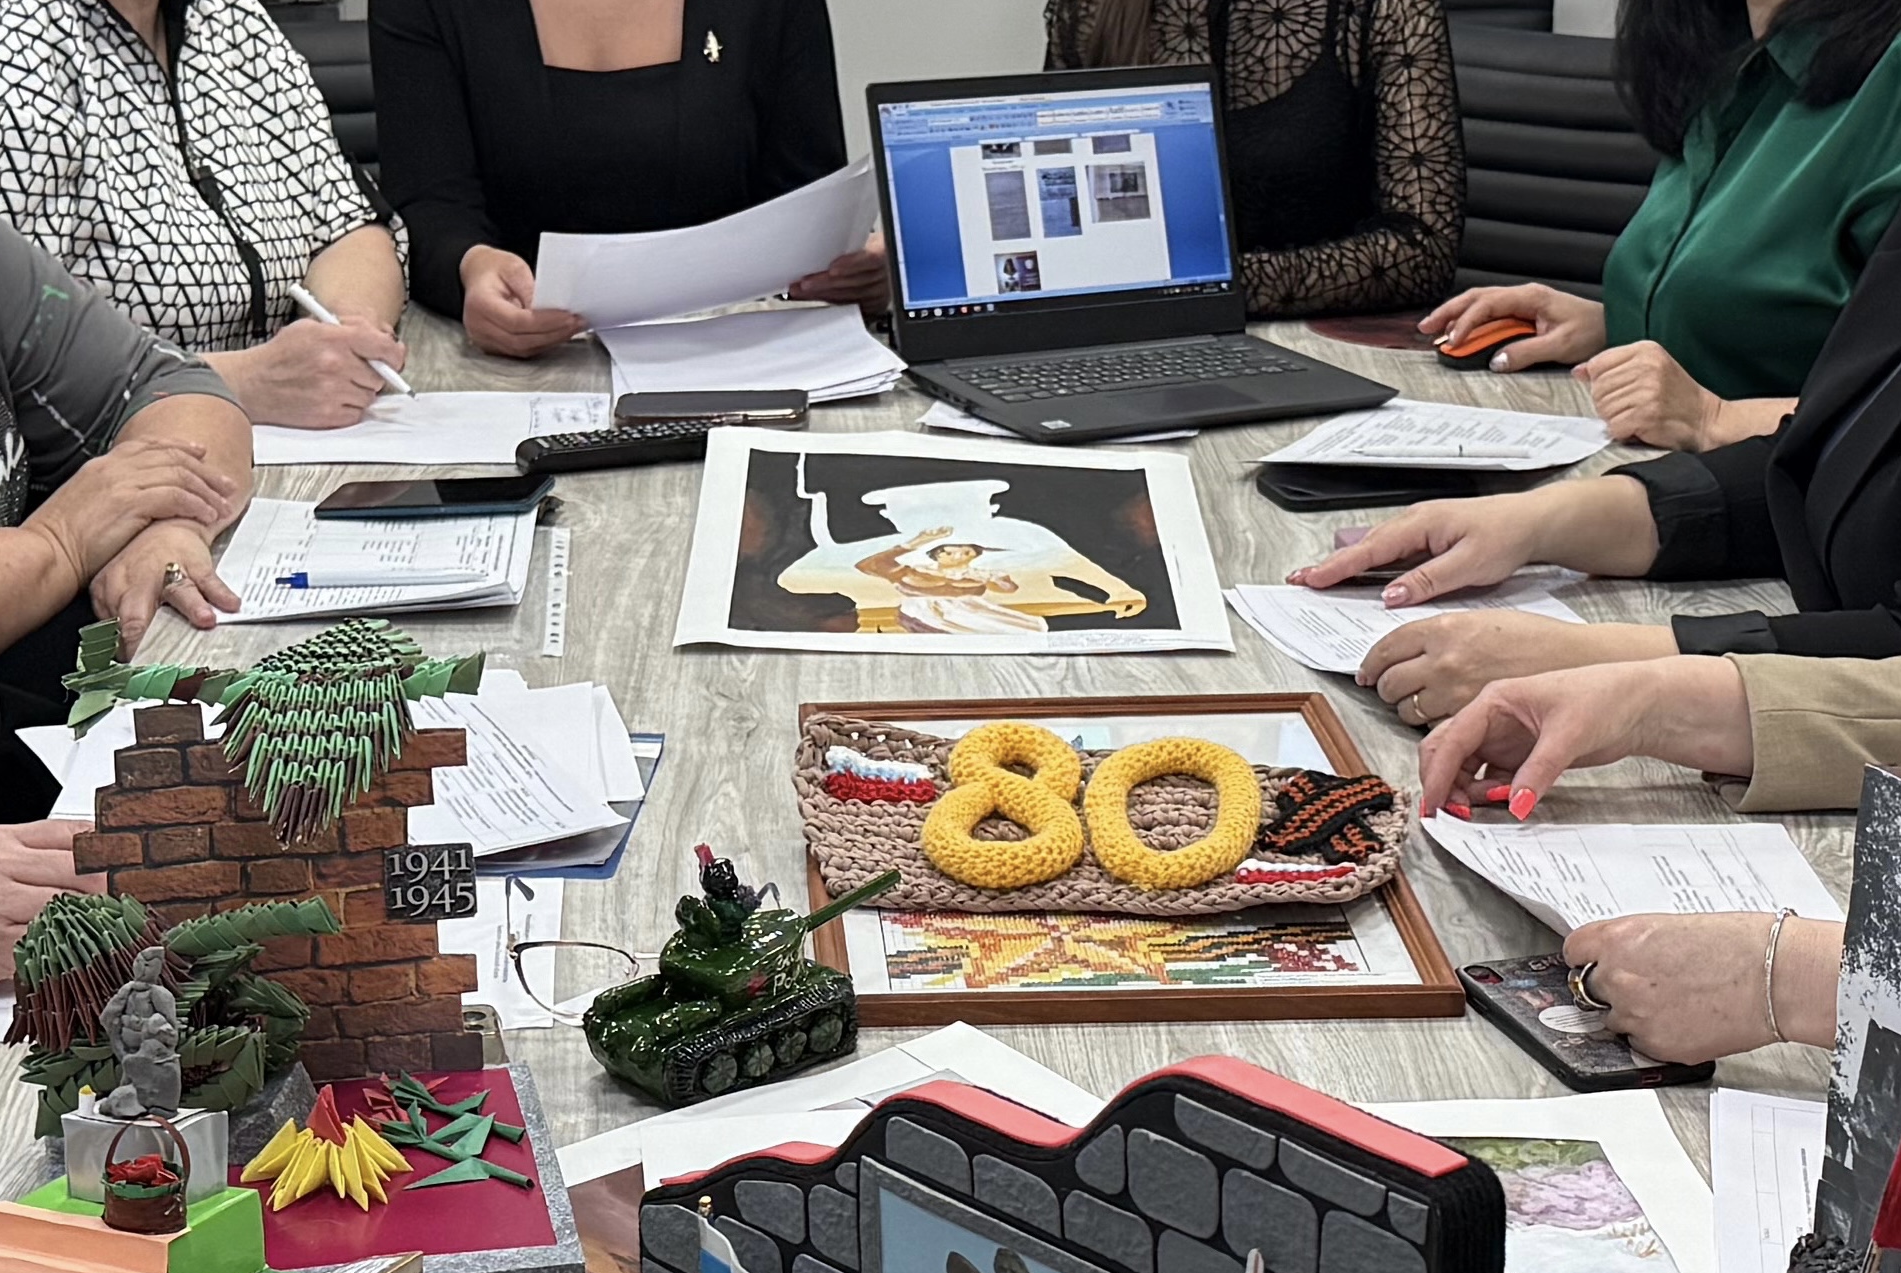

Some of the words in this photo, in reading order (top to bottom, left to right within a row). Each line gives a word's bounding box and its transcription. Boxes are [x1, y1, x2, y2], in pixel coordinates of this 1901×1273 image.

[922, 720, 1262, 892] 80
[389, 849, 472, 884] 1941
[391, 882, 476, 917] 1945
